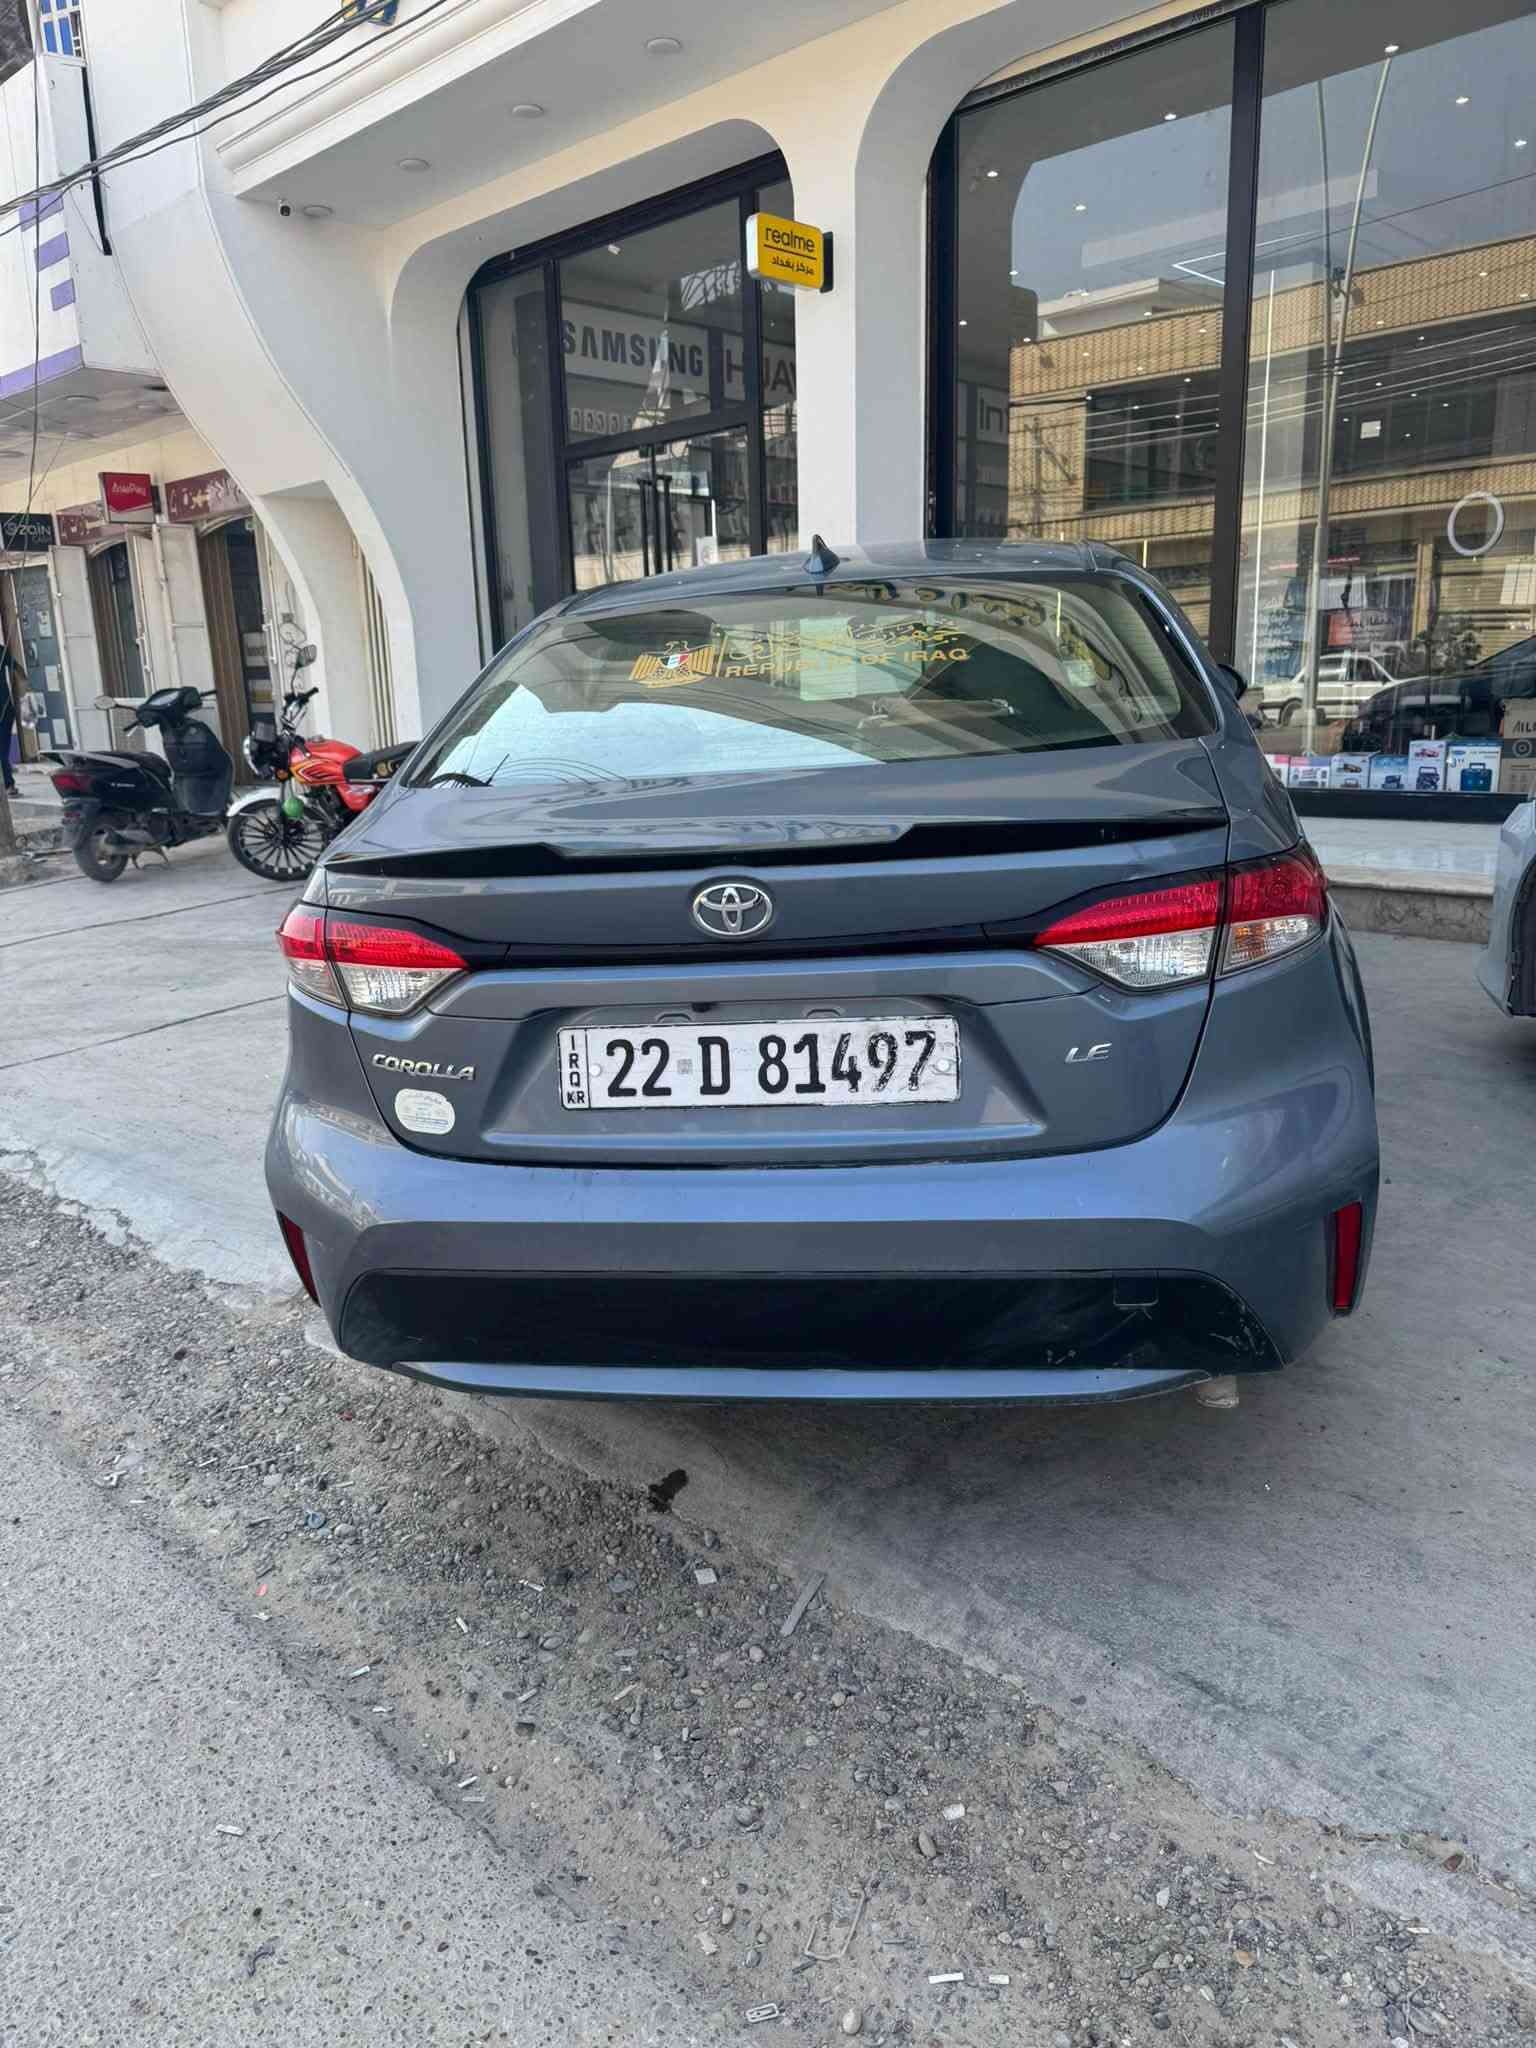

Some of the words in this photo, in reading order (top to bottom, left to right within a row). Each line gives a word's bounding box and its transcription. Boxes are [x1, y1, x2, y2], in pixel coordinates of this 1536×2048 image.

[765, 227, 816, 253] realme
[771, 256, 794, 272] بغداد
[795, 260, 815, 276] مركز
[859, 653, 898, 666] OF
[903, 647, 972, 665] IRAQ
[605, 1037, 673, 1098] 22
[697, 1035, 731, 1096] D
[757, 1030, 937, 1095] 81497
[1064, 1042, 1113, 1064] LE
[371, 1053, 477, 1081] COROLLA
